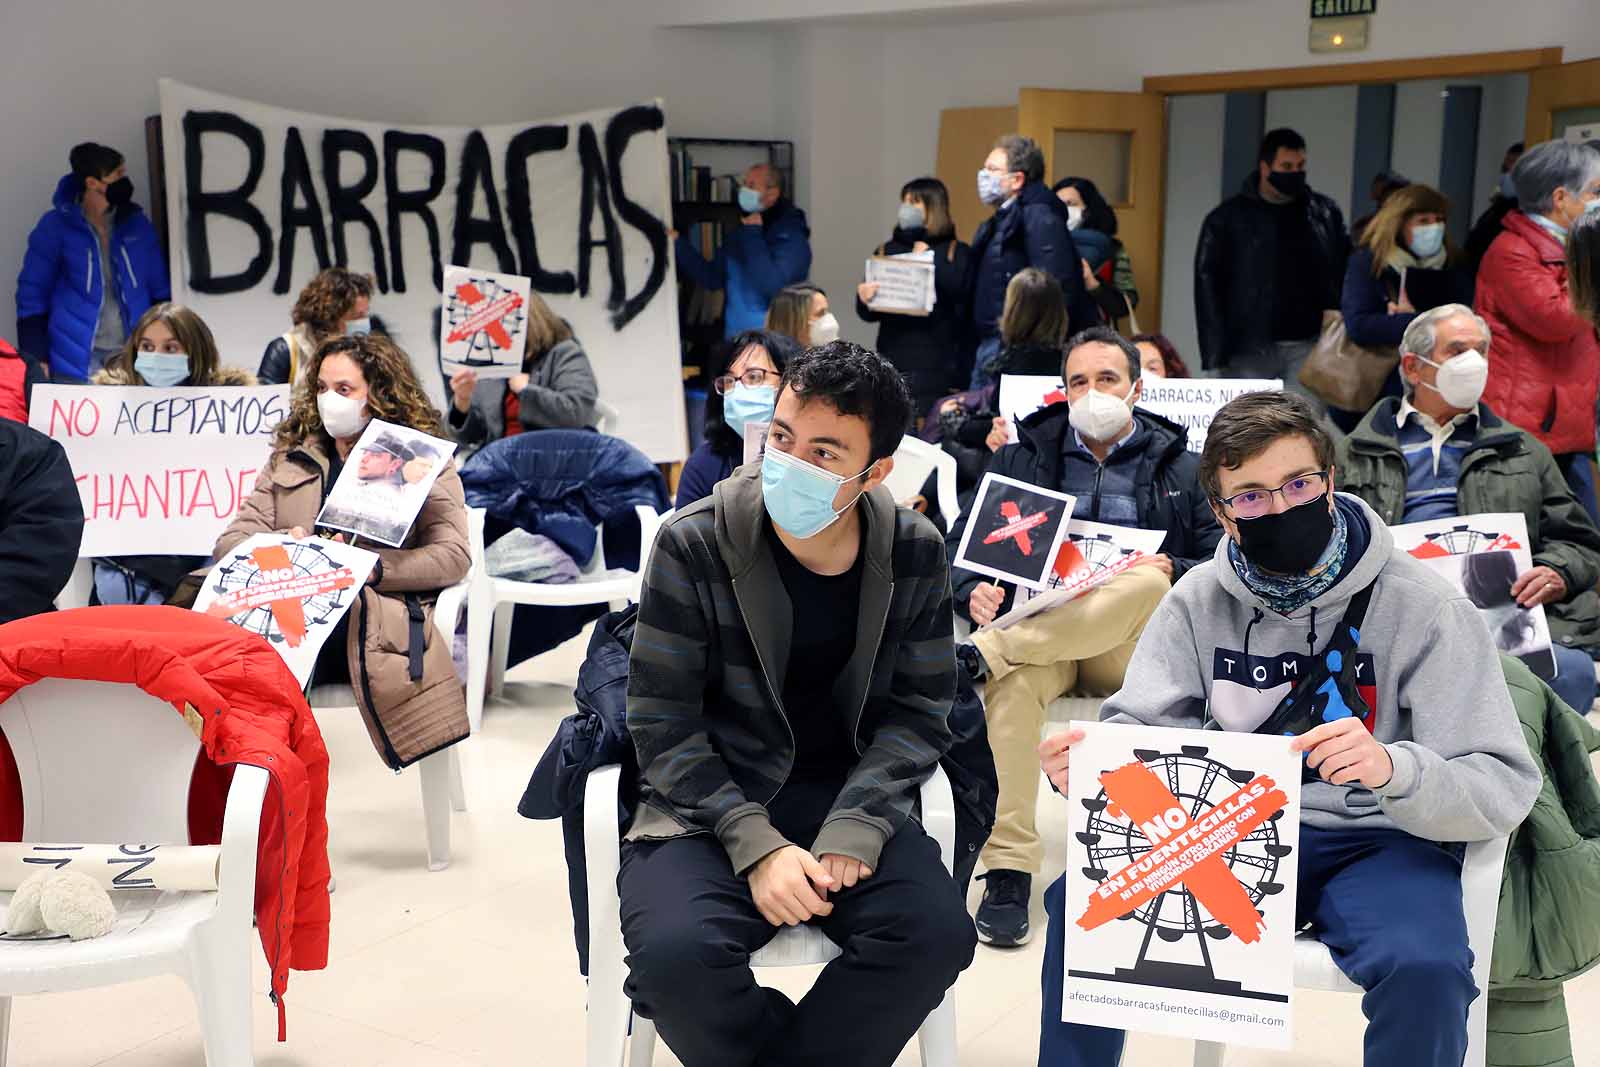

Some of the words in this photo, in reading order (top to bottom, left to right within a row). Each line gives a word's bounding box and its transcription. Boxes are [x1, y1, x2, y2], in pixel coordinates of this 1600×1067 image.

[1314, 0, 1373, 16] SALIDA
[183, 105, 668, 331] BARRACAS
[1141, 388, 1215, 405] BARRACAS,
[49, 398, 100, 437] NO
[114, 395, 283, 436] ACEPTAMOS
[1178, 414, 1211, 429] NING
[261, 567, 294, 584] NO
[1063, 568, 1092, 589] NO
[1223, 657, 1364, 682] TOMY
[1097, 871, 1126, 899] EN
[1126, 783, 1266, 880] FUENTECILLAS
[1142, 807, 1187, 846] NO
[1120, 889, 1132, 901] NI
[1131, 882, 1145, 895] EN
[1144, 858, 1180, 888] NINGÚN
[1179, 843, 1203, 863] OTRO
[1203, 820, 1237, 849] BARRIO
[1236, 806, 1256, 824] CON
[1148, 860, 1195, 892] VIVIENDAS
[1194, 829, 1240, 863] CERCANAS
[1069, 990, 1285, 1028] afectadosbarracasfuentecillas@gmail.com
